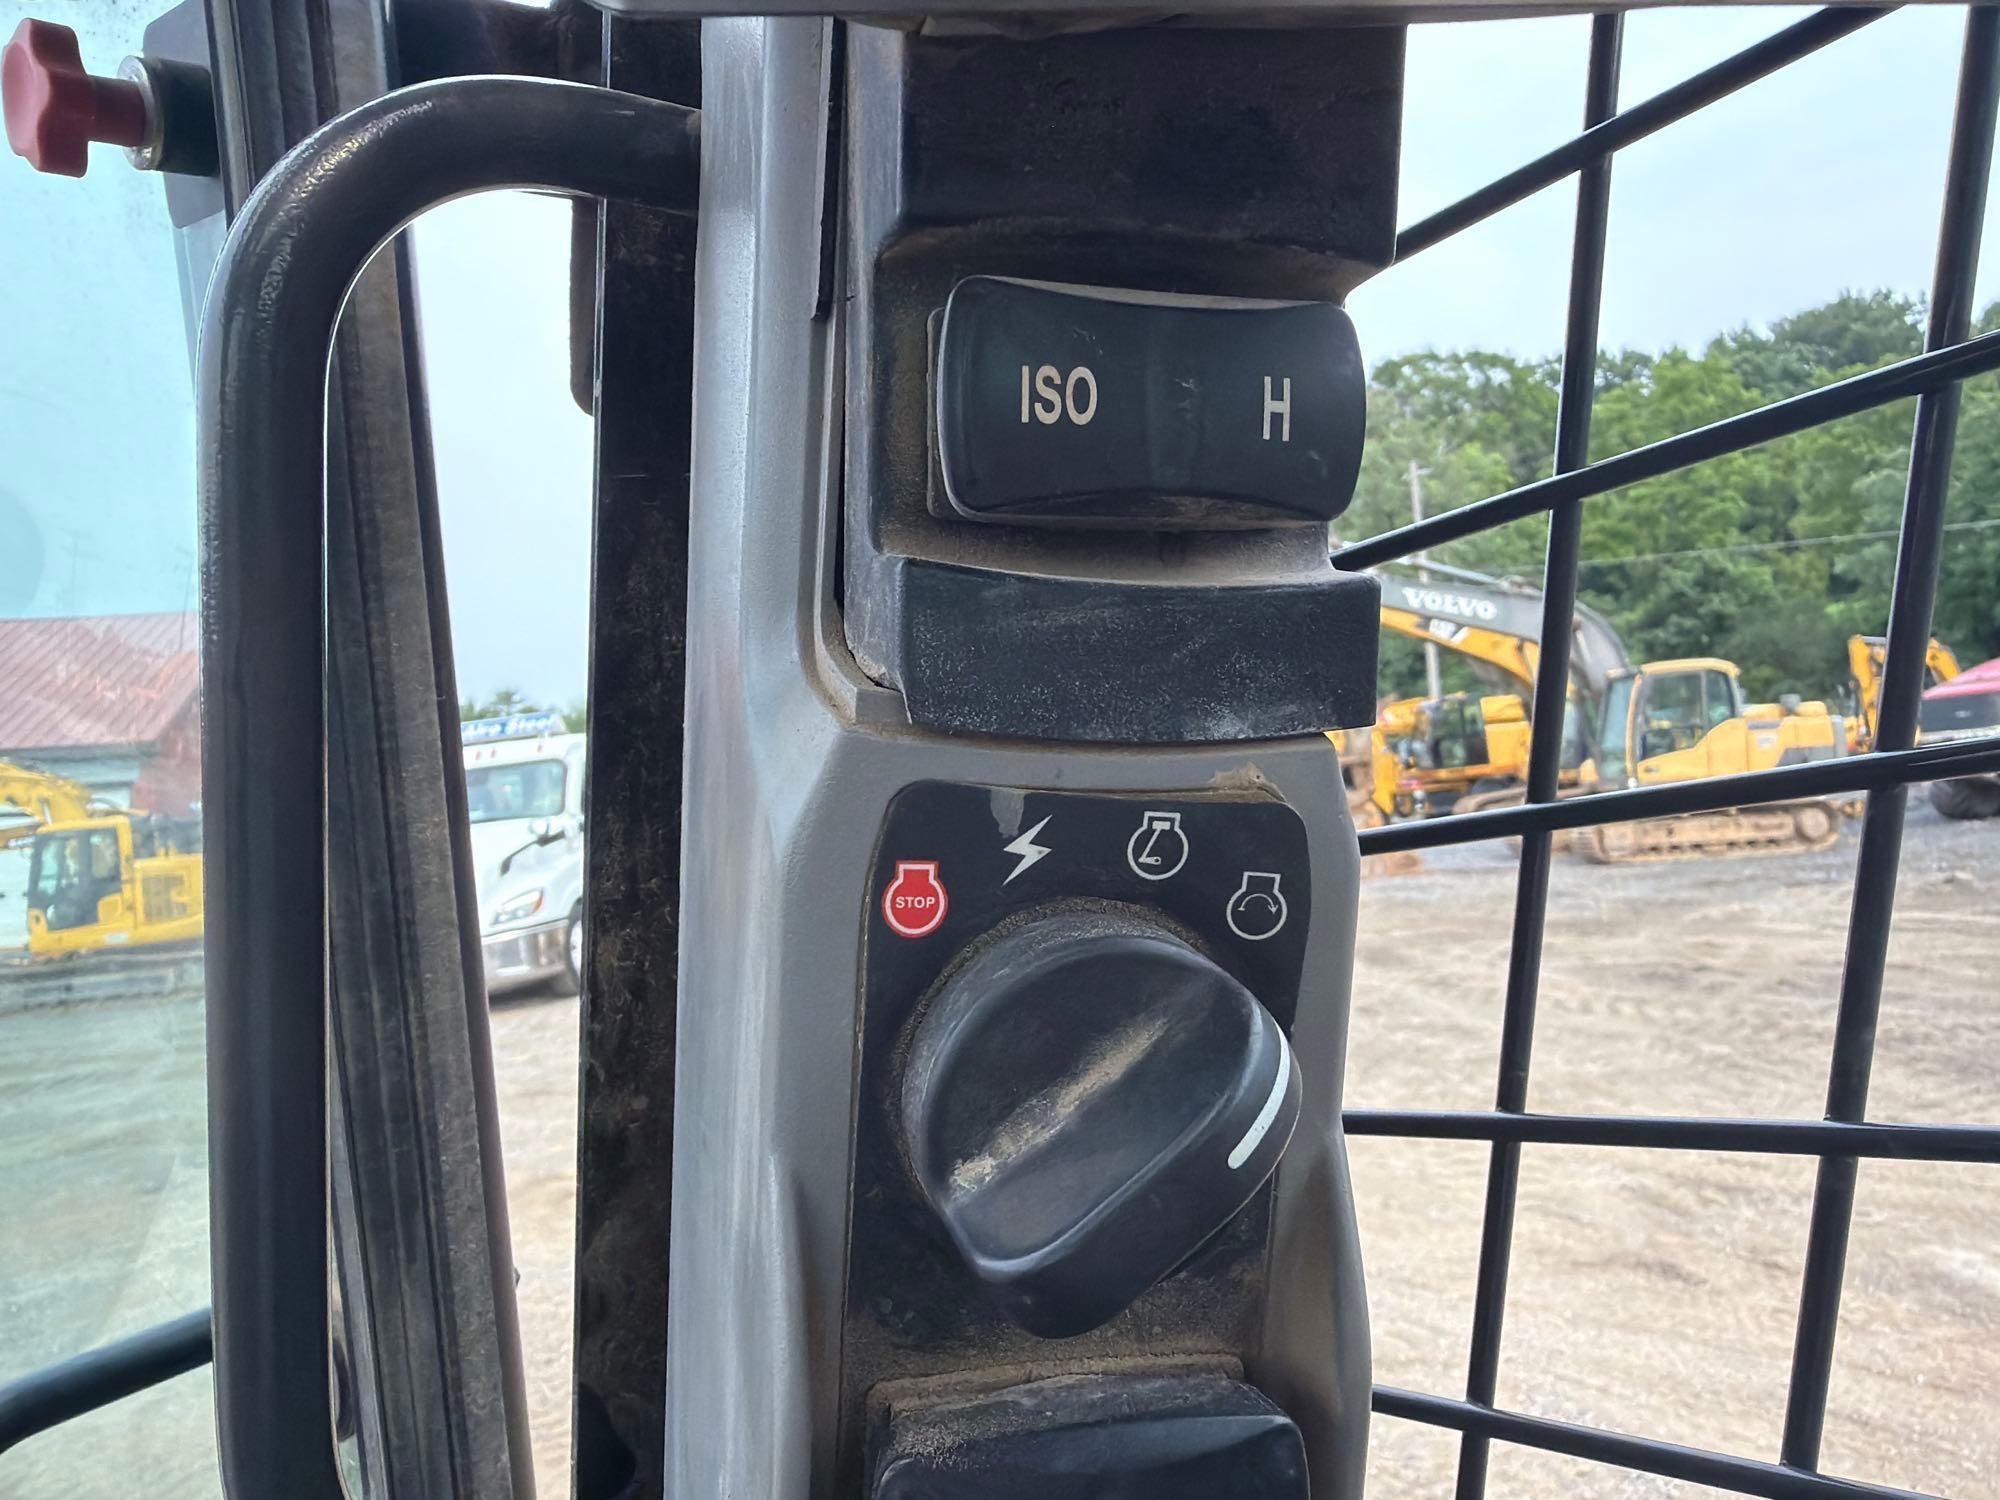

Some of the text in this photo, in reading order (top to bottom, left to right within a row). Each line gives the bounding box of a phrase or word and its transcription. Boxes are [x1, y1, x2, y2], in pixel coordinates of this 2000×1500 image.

[1020, 364, 1098, 426] ISO
[1262, 375, 1291, 442] H
[1402, 586, 1498, 620] VOLVO
[895, 896, 936, 909] STOP
